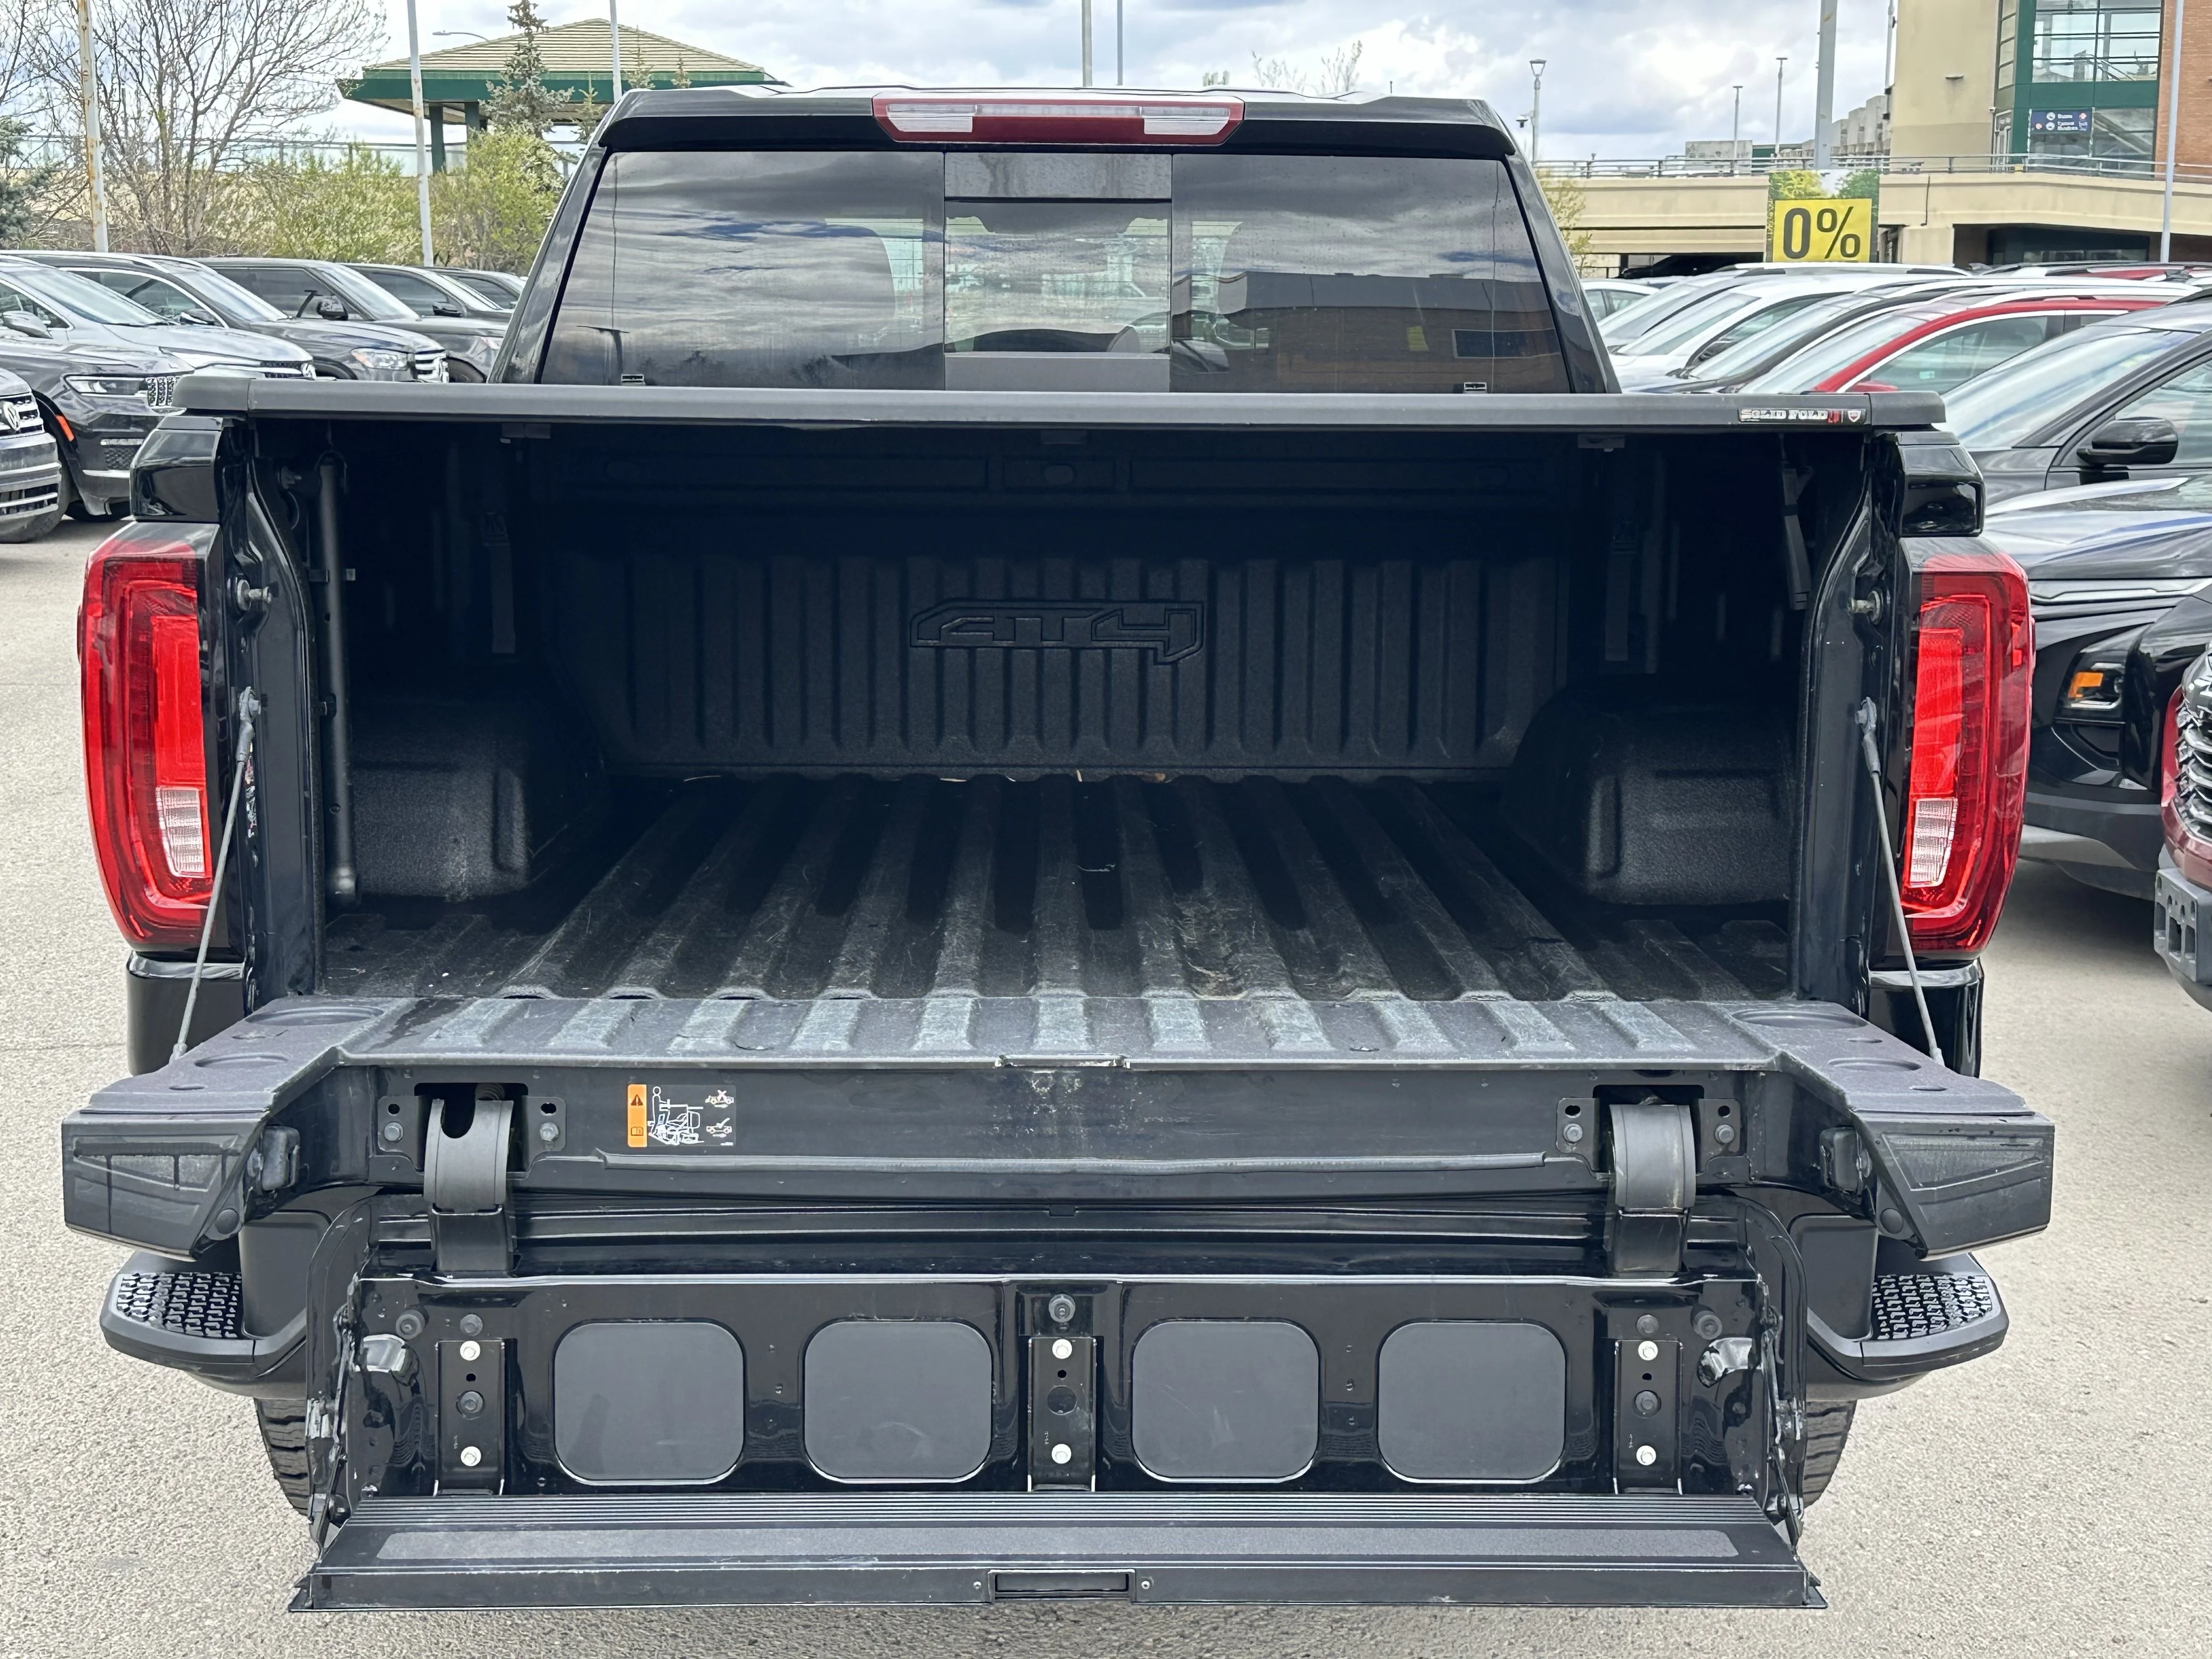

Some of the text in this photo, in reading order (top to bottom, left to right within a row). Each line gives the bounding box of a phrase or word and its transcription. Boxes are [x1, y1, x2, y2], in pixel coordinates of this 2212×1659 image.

[1783, 206, 1861, 259] 0%
[1788, 409, 1828, 420] FOLD
[910, 599, 1204, 665] AT4
